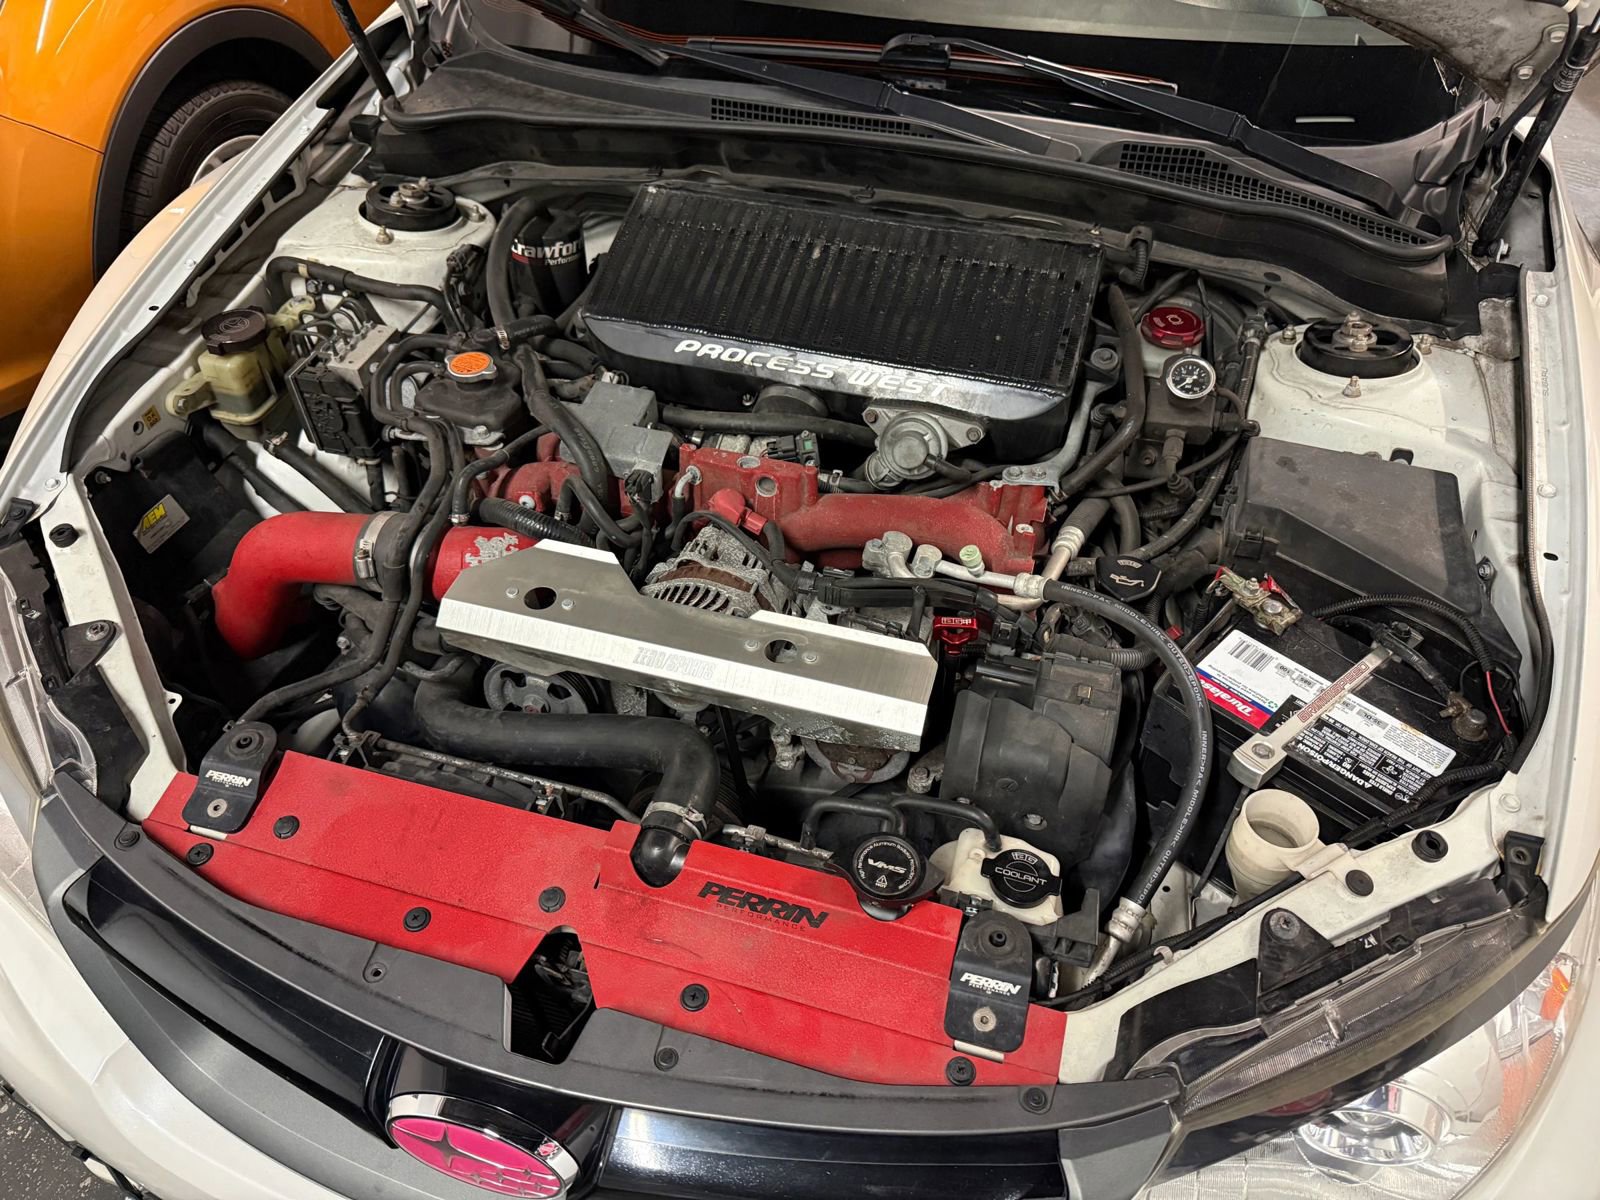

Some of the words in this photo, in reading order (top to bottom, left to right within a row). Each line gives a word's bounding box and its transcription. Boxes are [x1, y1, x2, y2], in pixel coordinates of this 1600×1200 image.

[675, 340, 835, 379] PROCESS
[848, 368, 953, 398] WEST
[205, 770, 252, 787] PERRIN
[995, 866, 1048, 885] COOLANT
[697, 881, 829, 928] PERRIN
[716, 903, 806, 931] PERFORMANCE
[960, 972, 1021, 995] PERRIN
